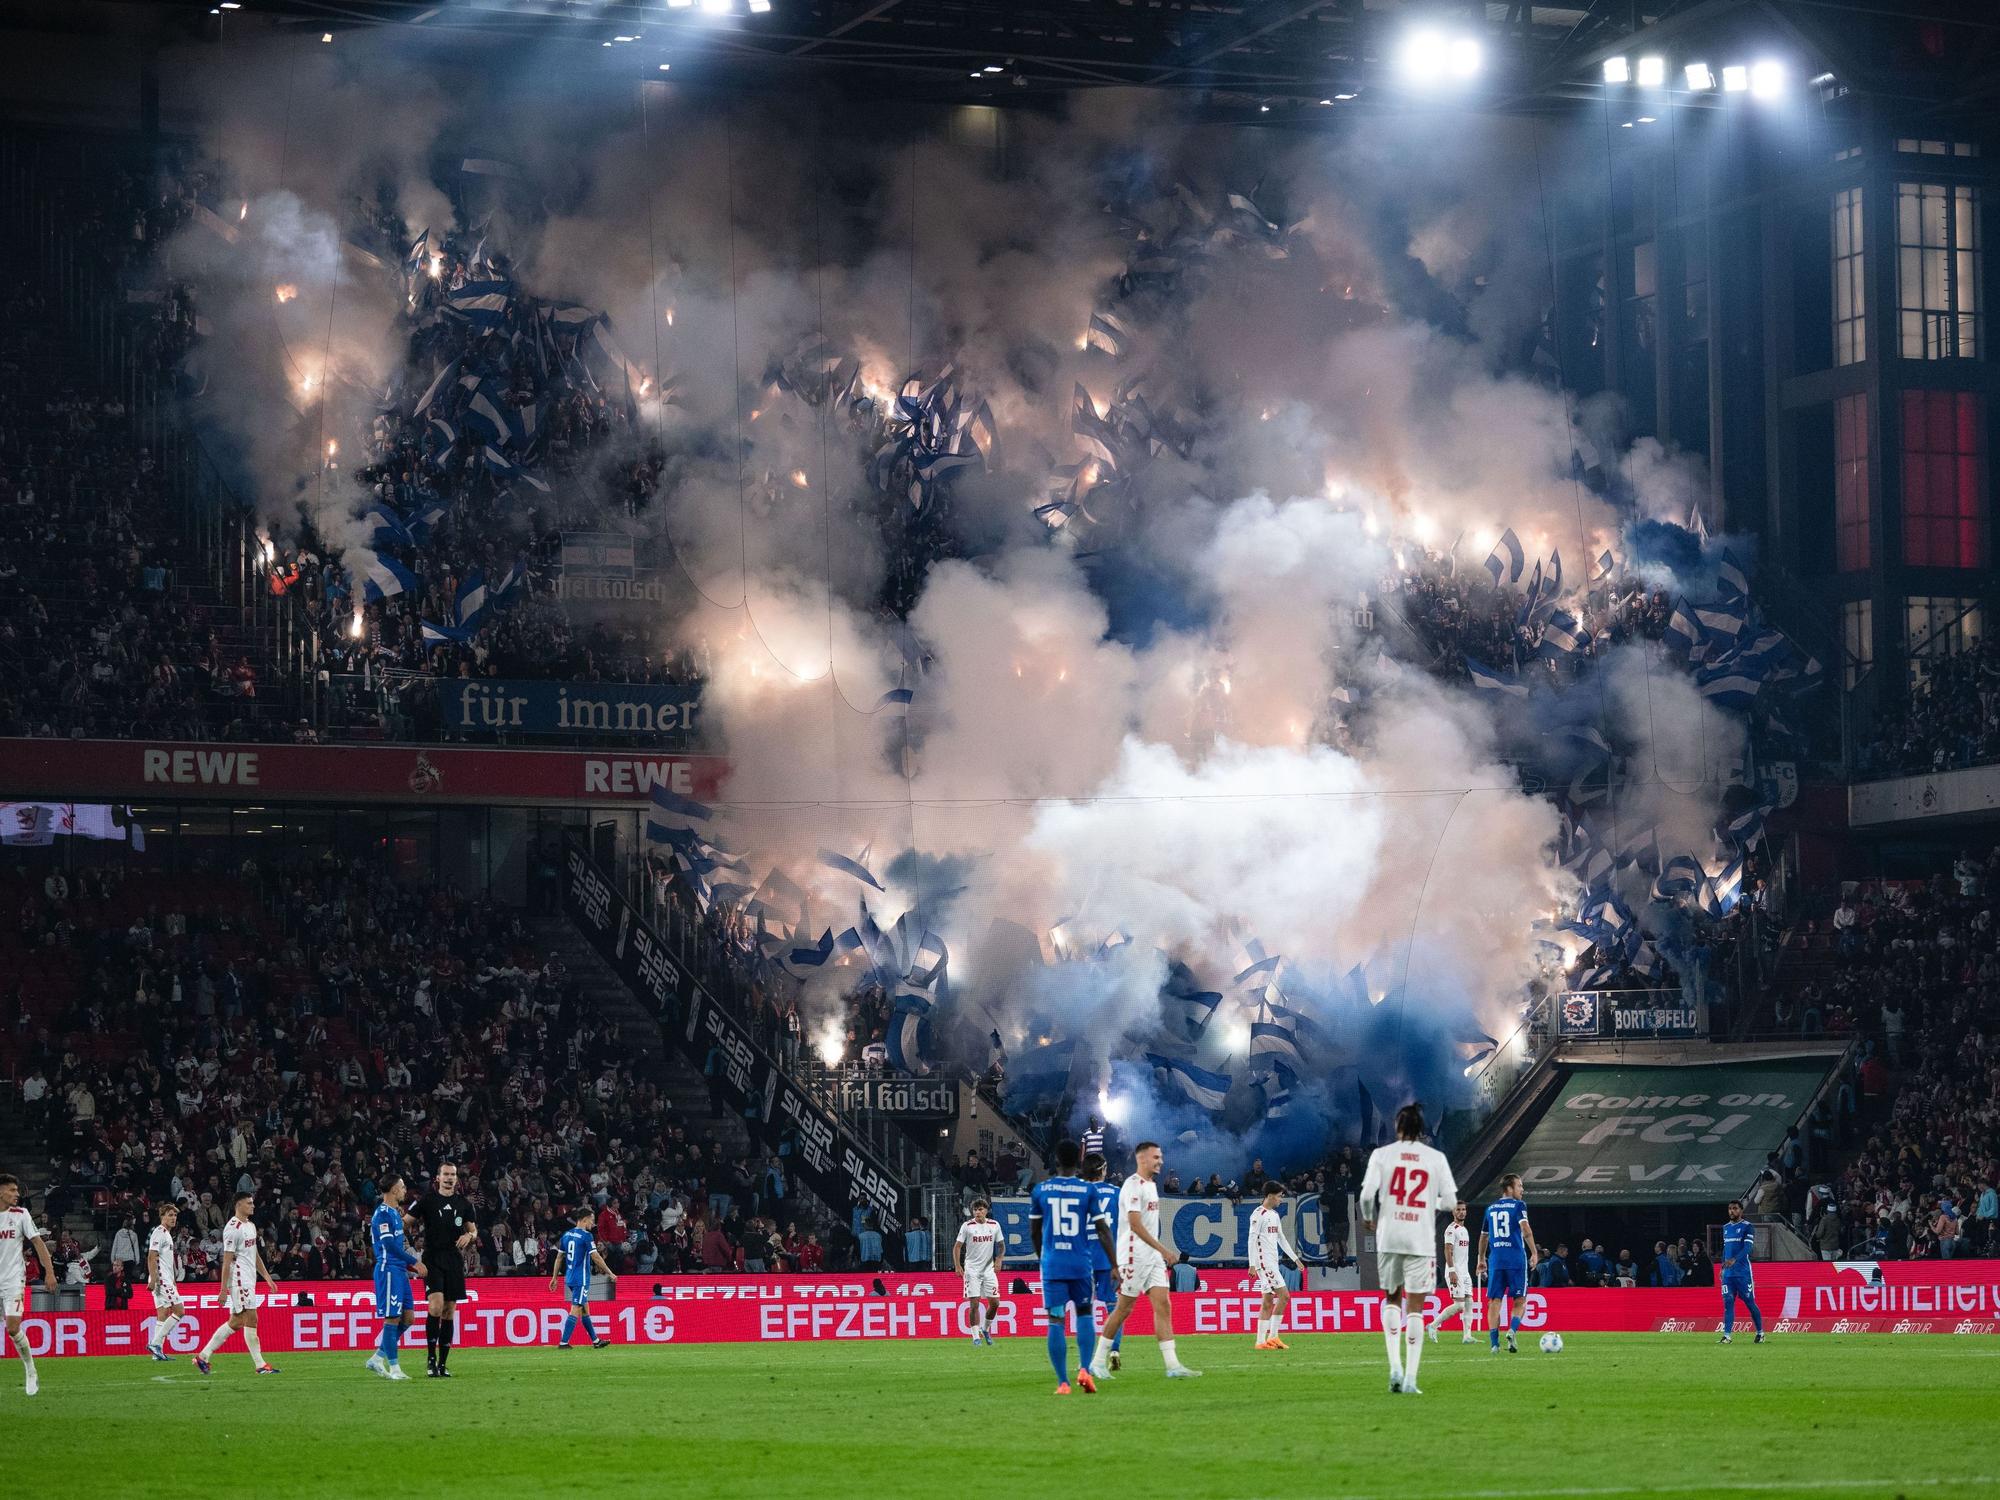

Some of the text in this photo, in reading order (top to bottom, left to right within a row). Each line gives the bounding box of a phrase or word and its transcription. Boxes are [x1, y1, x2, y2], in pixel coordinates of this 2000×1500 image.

[459, 683, 698, 731] für immer
[144, 749, 260, 785] REWE
[584, 761, 693, 794] REWE
[568, 850, 611, 912] SILBER
[570, 878, 603, 931] PFEIL
[634, 928, 680, 992] SILBER
[705, 1009, 755, 1075] SILBER
[1565, 1093, 1794, 1109] Come on,
[780, 1089, 834, 1154] SILBER
[1577, 1114, 1752, 1144] FC!
[842, 1148, 898, 1214] SILBER
[1389, 1166, 1429, 1208] 42
[1519, 1164, 1733, 1183] DEVK
[0, 1229, 16, 1240] WE
[1047, 1197, 1080, 1237] 15
[1490, 1210, 1511, 1238] 13
[567, 1240, 576, 1262] 9
[972, 1235, 993, 1243] REWE
[0, 1317, 87, 1356] OR
[618, 1305, 675, 1343] 1€
